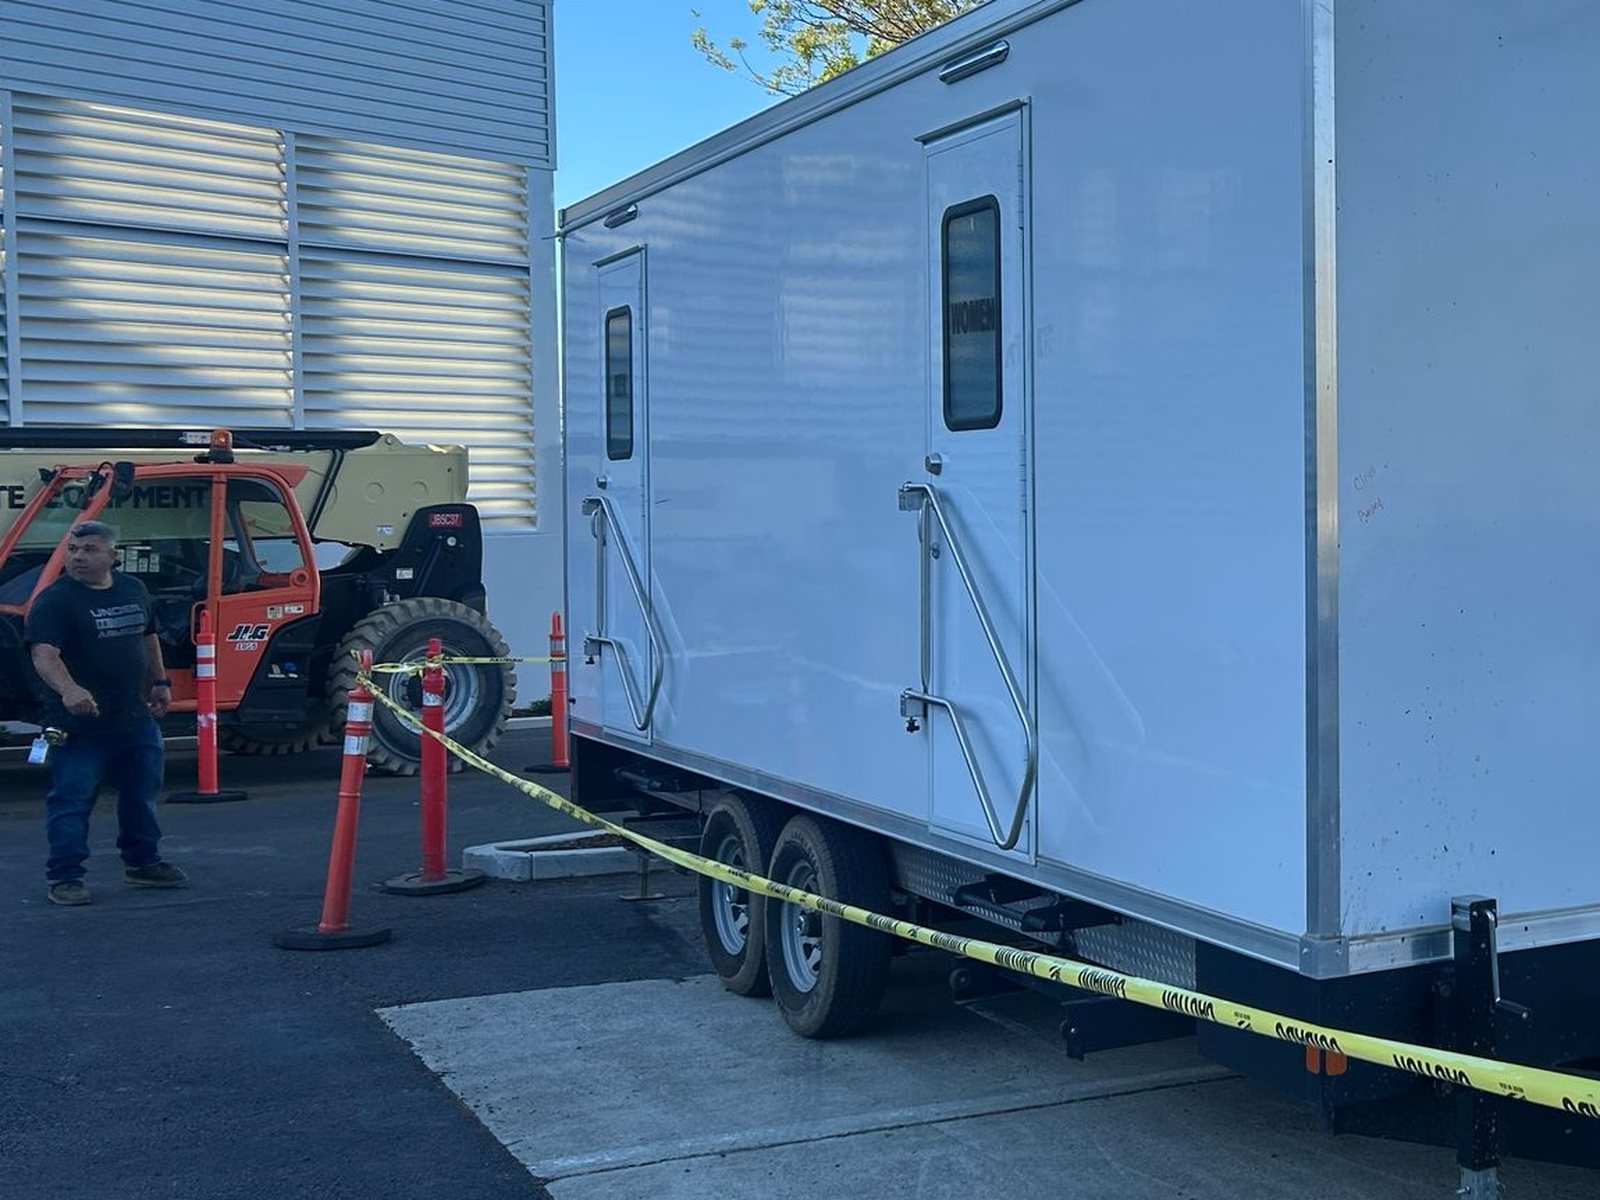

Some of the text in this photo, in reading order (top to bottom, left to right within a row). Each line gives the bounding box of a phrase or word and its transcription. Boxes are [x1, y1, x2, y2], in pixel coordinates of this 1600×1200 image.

[951, 297, 995, 334] WOMEN
[44, 485, 208, 509] EQPMENT
[226, 623, 271, 641] JLG
